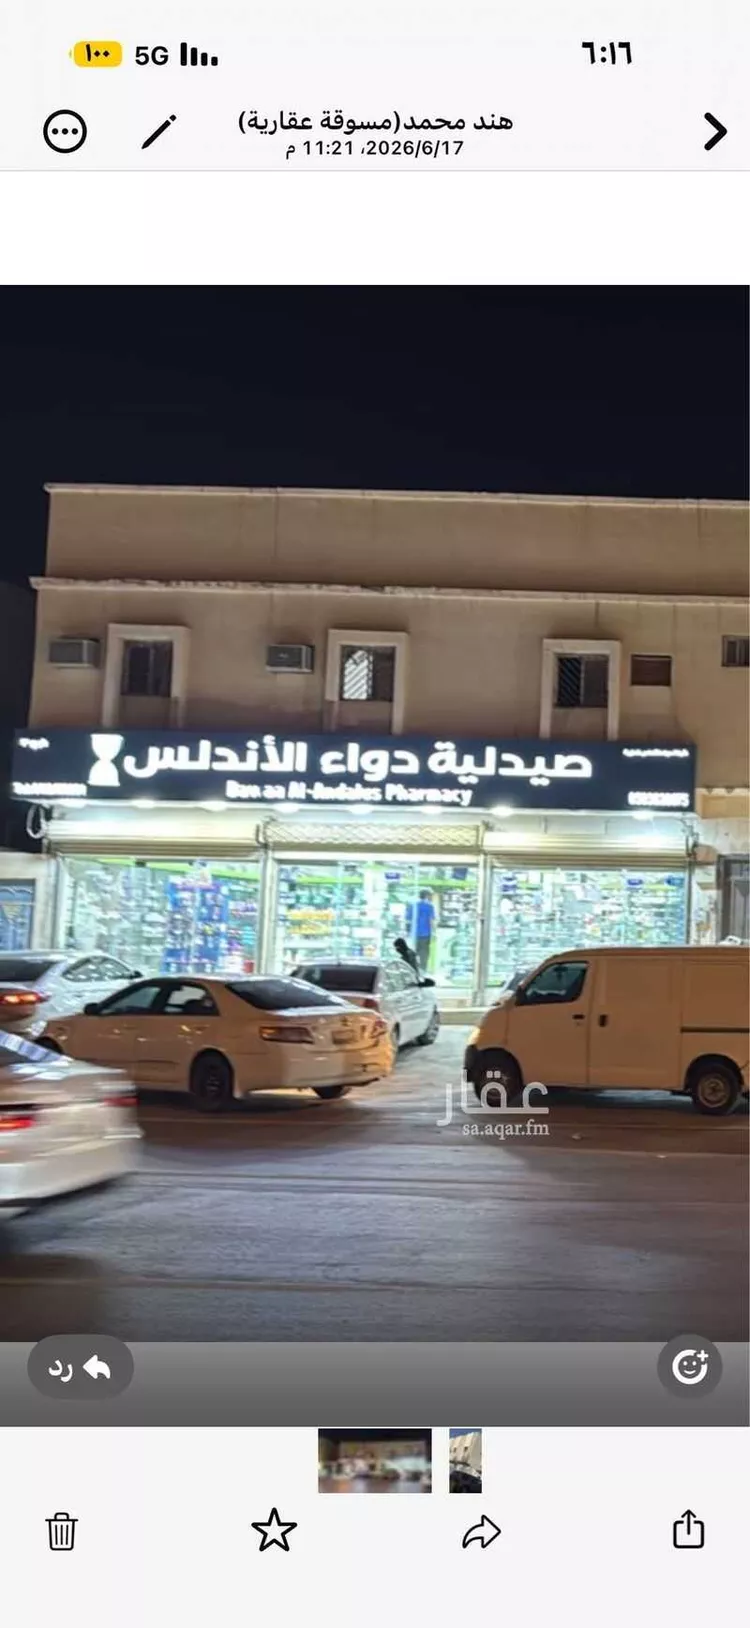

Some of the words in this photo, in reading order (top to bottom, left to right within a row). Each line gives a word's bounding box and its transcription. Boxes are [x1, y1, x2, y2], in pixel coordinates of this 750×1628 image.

[135, 46, 169, 66] 5G
[581, 41, 632, 65] ٦:١٦
[238, 110, 313, 135] عقارية)
[473, 113, 513, 130] هند
[285, 144, 296, 160] م
[303, 140, 352, 156] 11:21
[122, 734, 307, 778] الأندلس
[319, 742, 420, 781] دواء
[427, 741, 593, 786] صيدلية
[384, 783, 473, 807] Pharmacy
[48, 1359, 74, 1383] رد
